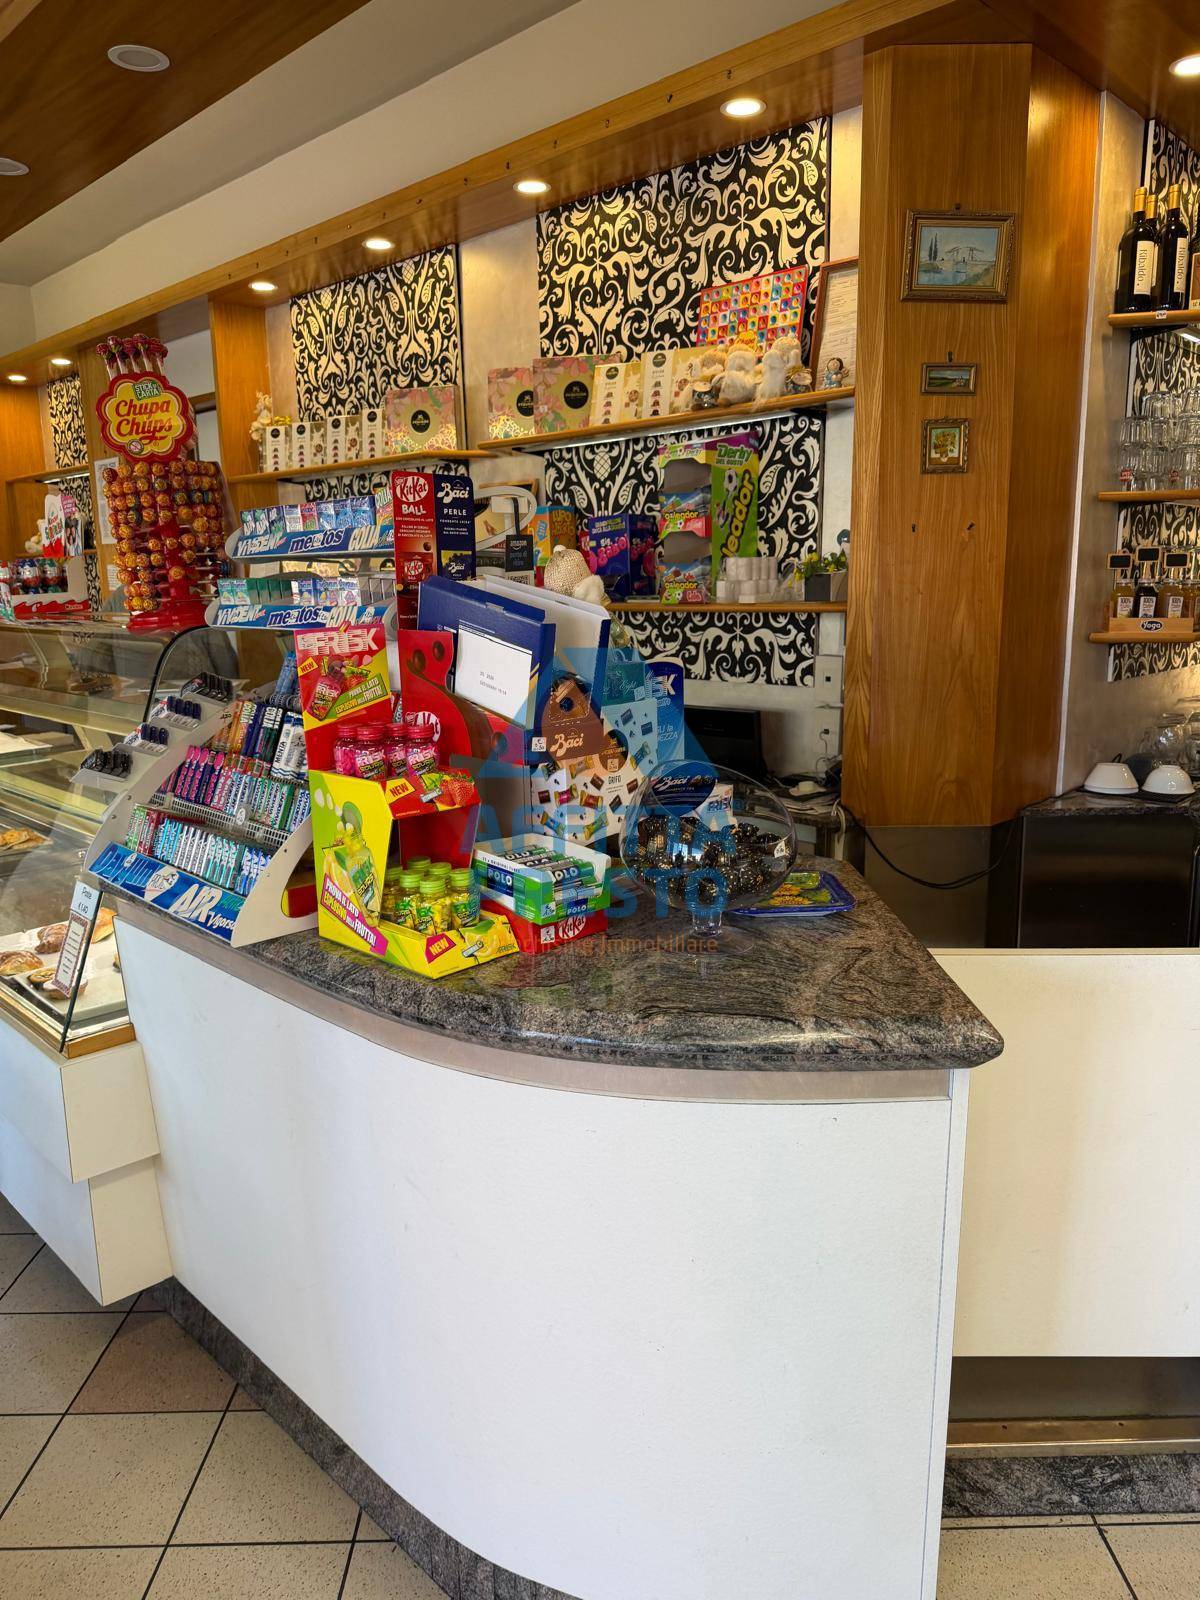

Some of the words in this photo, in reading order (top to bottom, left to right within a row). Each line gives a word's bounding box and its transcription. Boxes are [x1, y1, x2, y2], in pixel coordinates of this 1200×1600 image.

[115, 399, 171, 418] Chupa
[116, 417, 173, 437] Chups
[717, 444, 753, 462] Derby
[399, 476, 428, 501] KitKat
[437, 482, 469, 503] Baci
[402, 504, 426, 516] BALL
[443, 508, 467, 516] PERLE
[721, 469, 755, 557] leador
[288, 528, 345, 553] mentos
[267, 606, 322, 627] mentos
[1143, 621, 1162, 631] Yoga
[300, 628, 379, 656] FRISK
[274, 740, 287, 763] MENTA
[550, 734, 584, 757] Baci
[389, 782, 409, 797] NEW
[506, 851, 531, 860] OLO
[487, 868, 513, 886] POLO
[554, 867, 578, 882] OLO
[169, 883, 222, 923] AIR
[567, 904, 588, 916] POLO
[206, 910, 236, 931] Vigorso
[560, 915, 586, 938] KitKat
[429, 938, 450, 956] NEW
